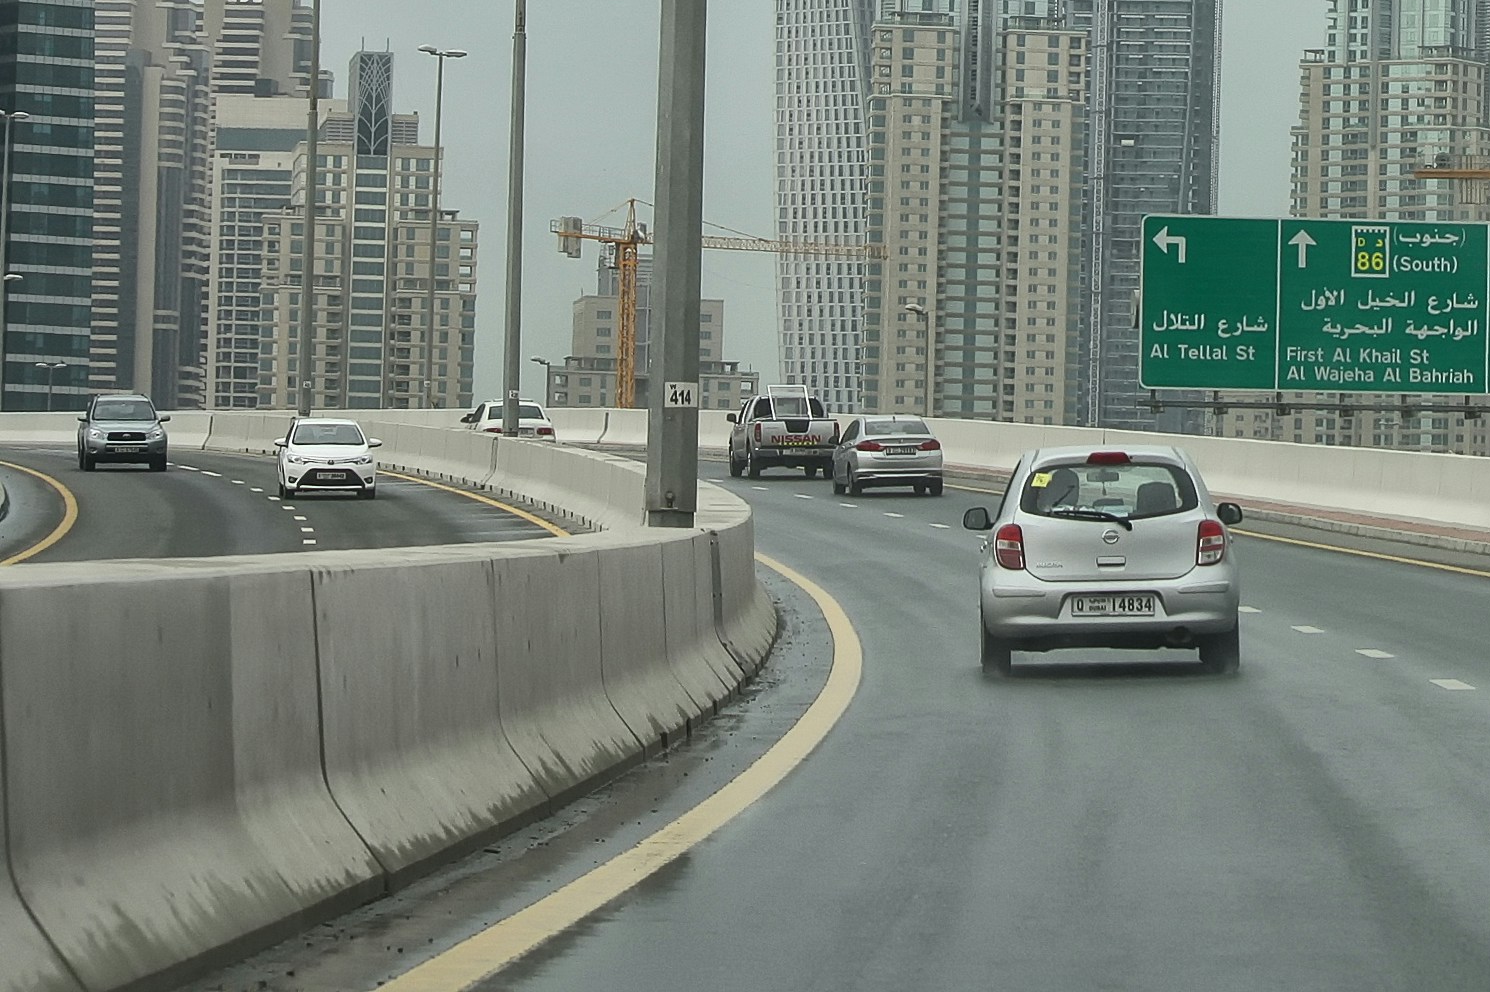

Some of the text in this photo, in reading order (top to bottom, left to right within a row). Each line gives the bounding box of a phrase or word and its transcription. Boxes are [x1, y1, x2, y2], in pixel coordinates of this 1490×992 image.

[1357, 237, 1366, 247] D
[1357, 251, 1384, 271] 86
[1393, 255, 1458, 274] (South)
[1357, 289, 1416, 310] الخيل
[1427, 292, 1479, 315] شارع
[1152, 310, 1268, 338] شارع التلال
[1321, 317, 1478, 341] الواجهة البحرية
[1150, 343, 1256, 361] Al Tellal St
[1286, 346, 1430, 365] First Al Khail St
[1286, 365, 1474, 384] Al Wajeha Al Bahriah
[669, 389, 691, 405] 414
[771, 434, 821, 444] NISSAN
[1112, 597, 1152, 612] 14834
